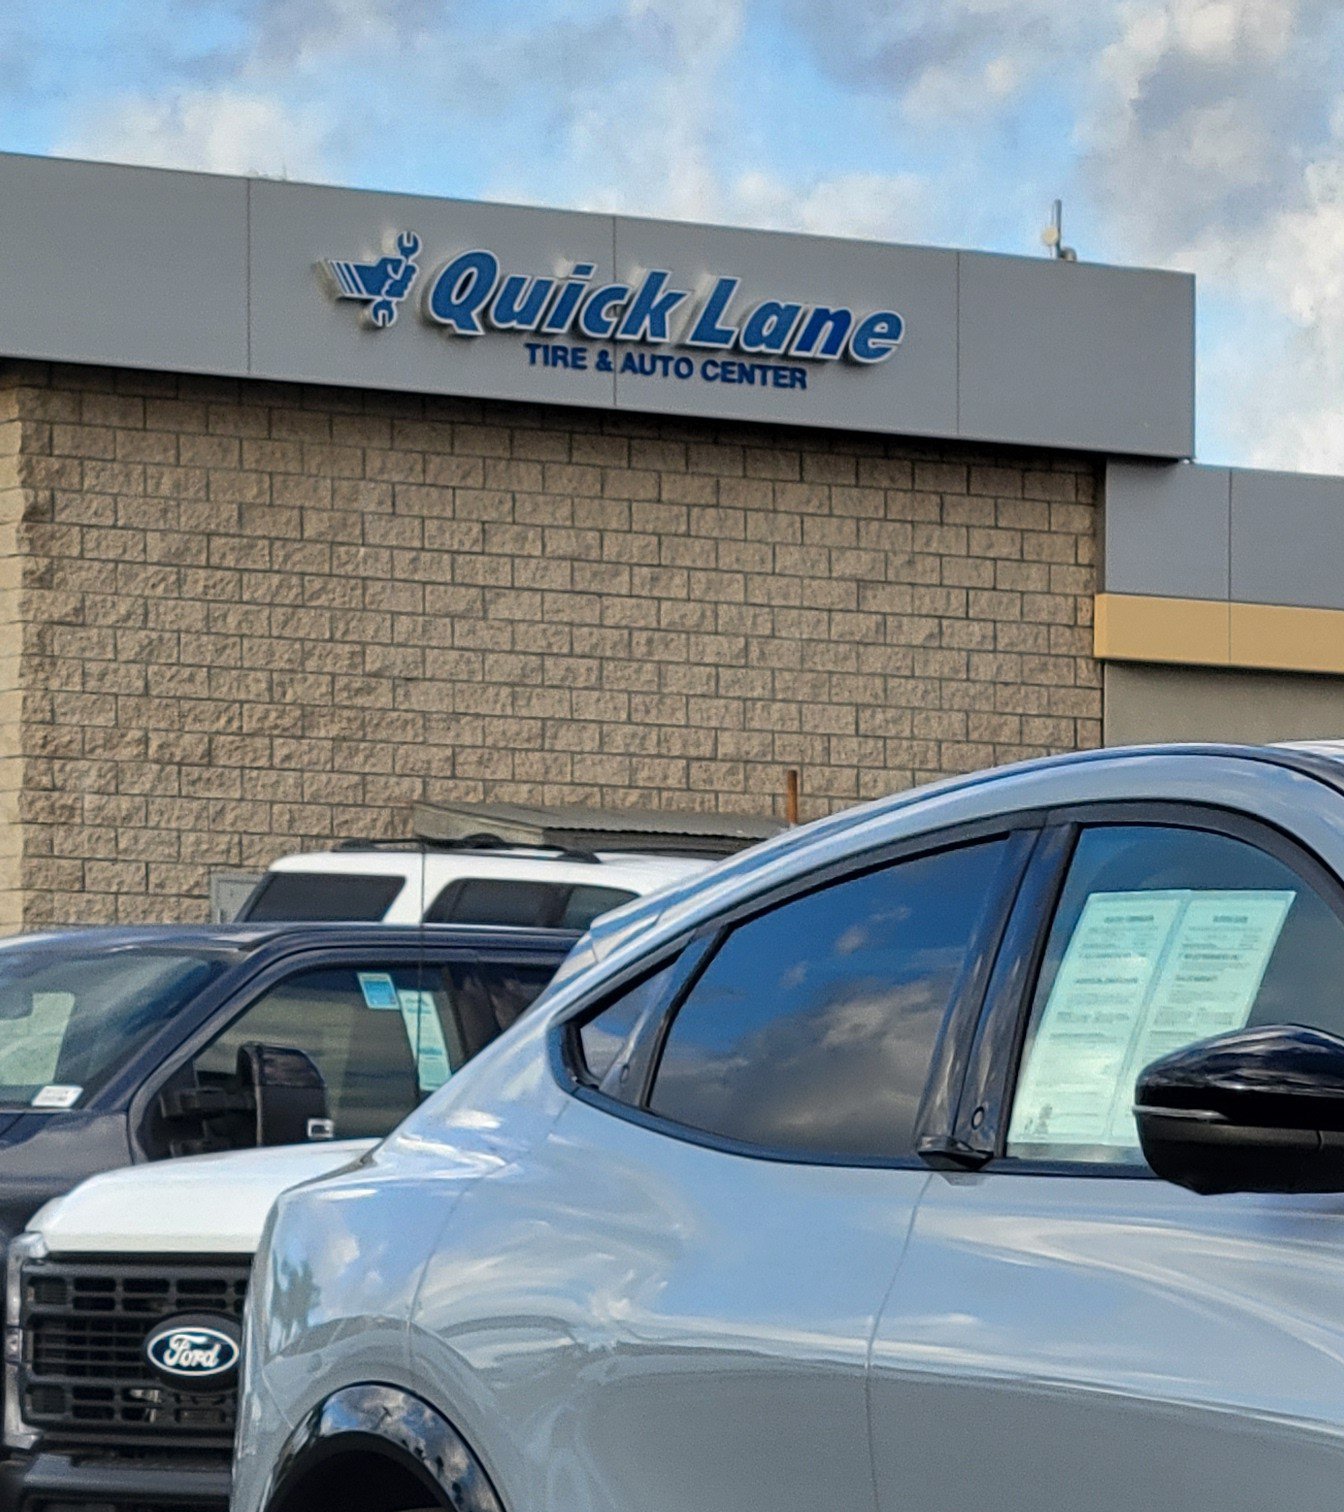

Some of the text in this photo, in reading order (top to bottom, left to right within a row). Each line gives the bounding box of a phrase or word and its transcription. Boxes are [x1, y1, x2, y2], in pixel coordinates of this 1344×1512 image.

[427, 248, 905, 363] Quick Lane
[525, 342, 808, 391] TIRE & AUTO CENTER
[163, 1333, 221, 1368] Ford
